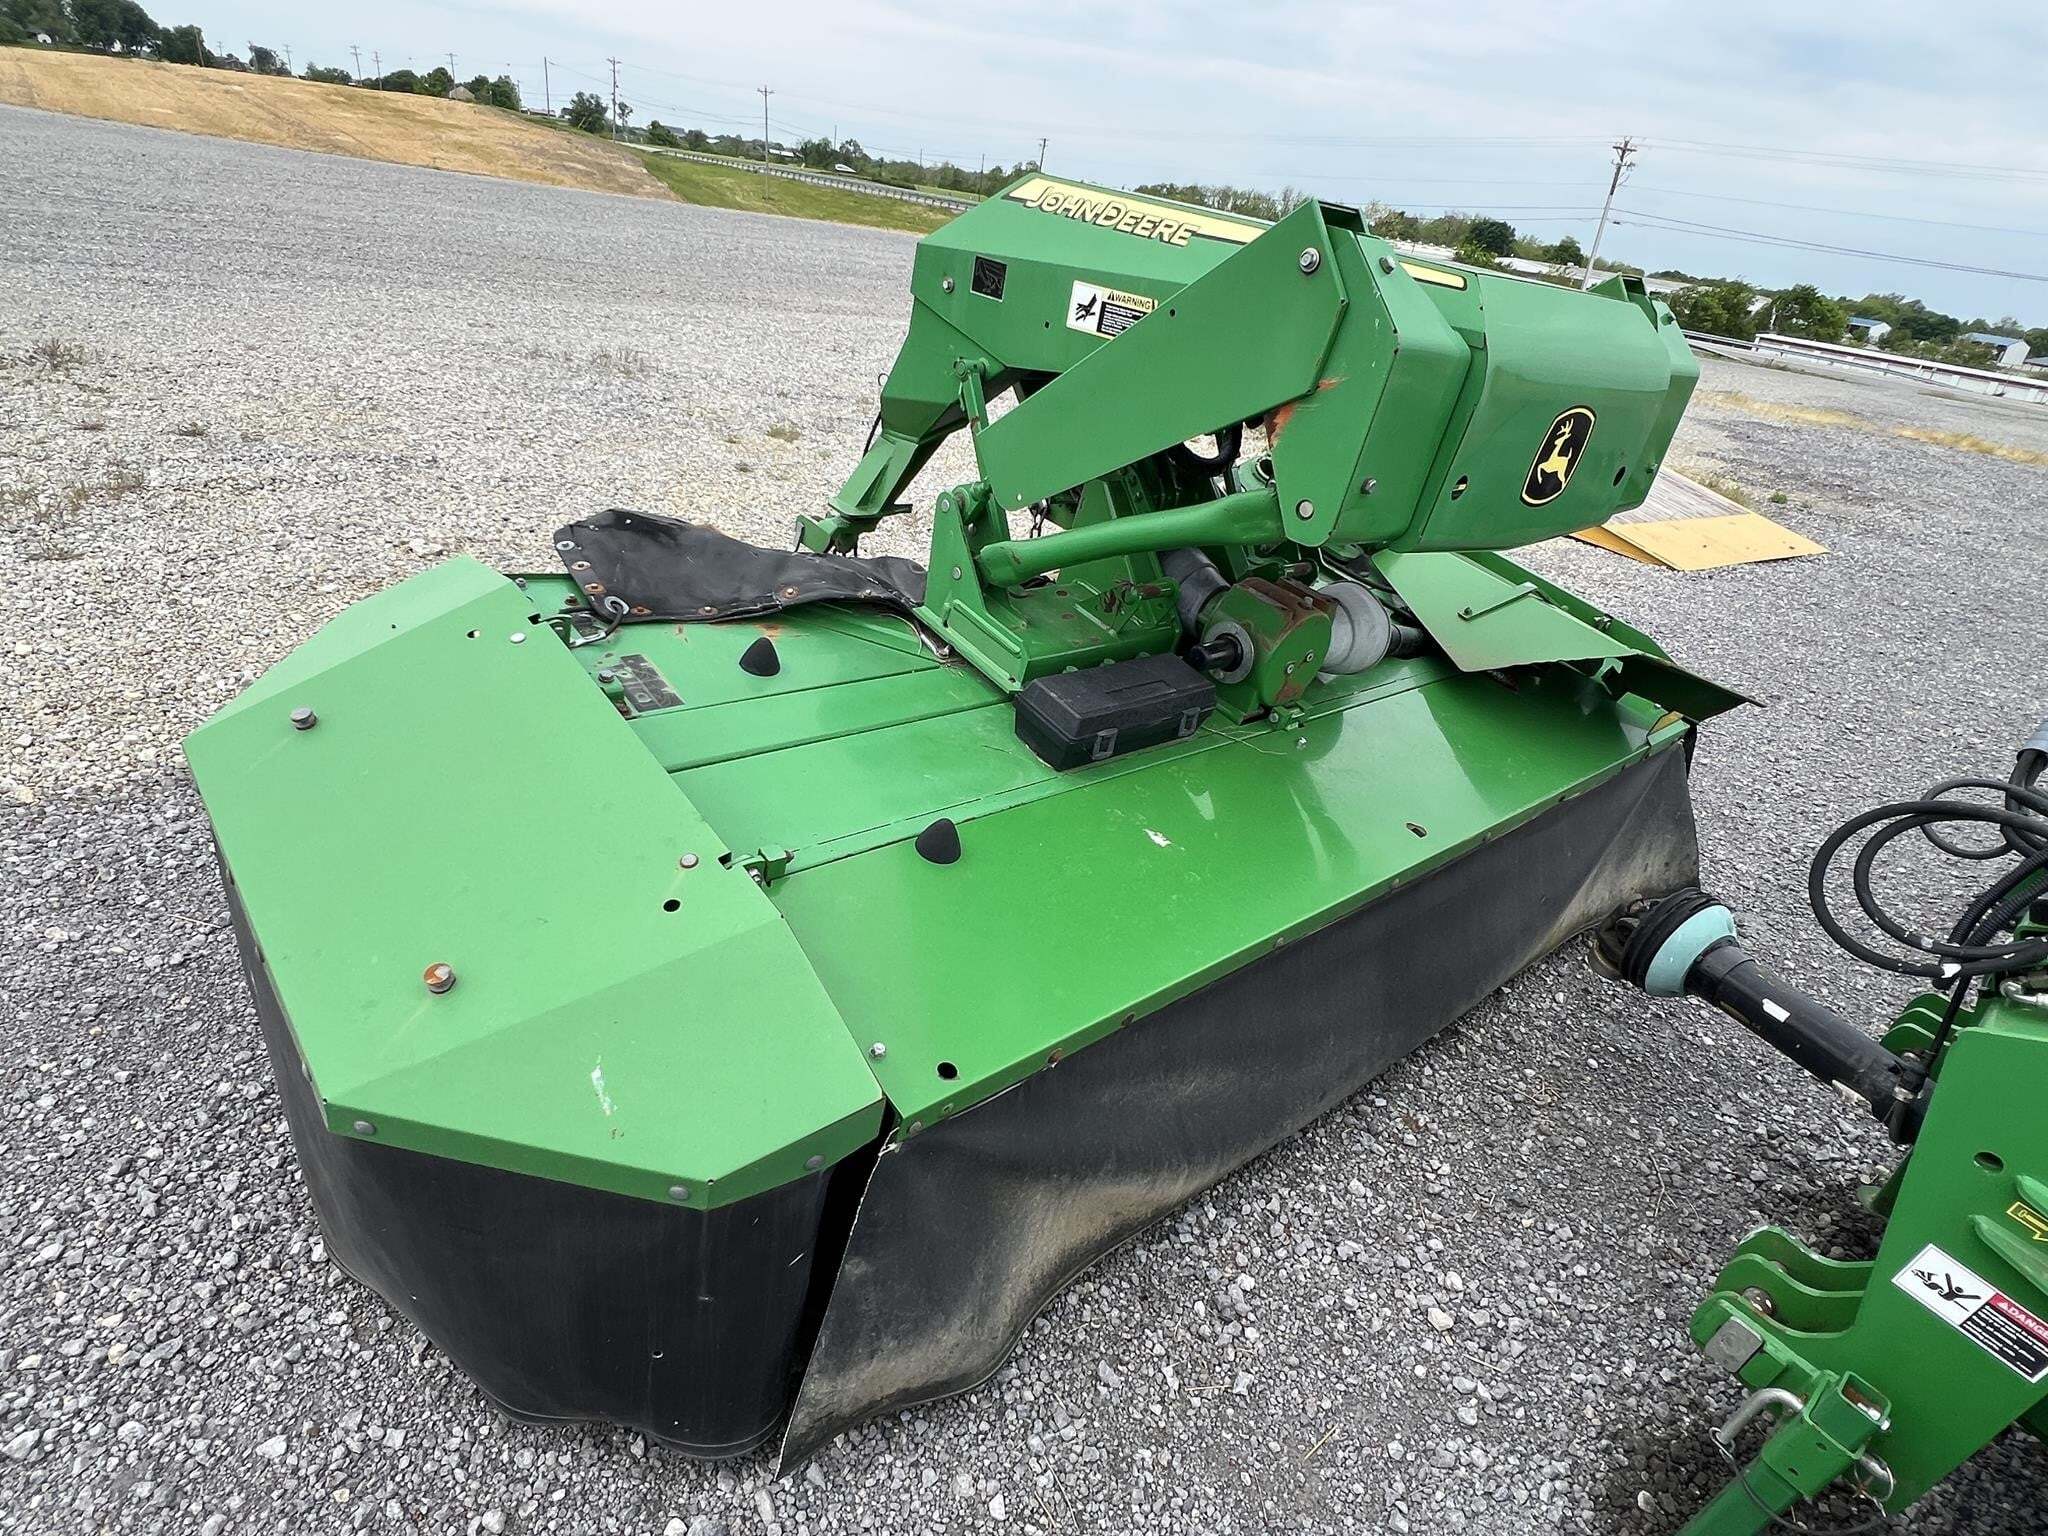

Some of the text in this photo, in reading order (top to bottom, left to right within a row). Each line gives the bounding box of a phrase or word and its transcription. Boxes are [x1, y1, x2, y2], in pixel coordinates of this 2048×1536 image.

[1024, 186, 1200, 247] JOHN DEERE
[1115, 293, 1151, 310] WARNING
[2009, 1307, 2048, 1339] DANGE
